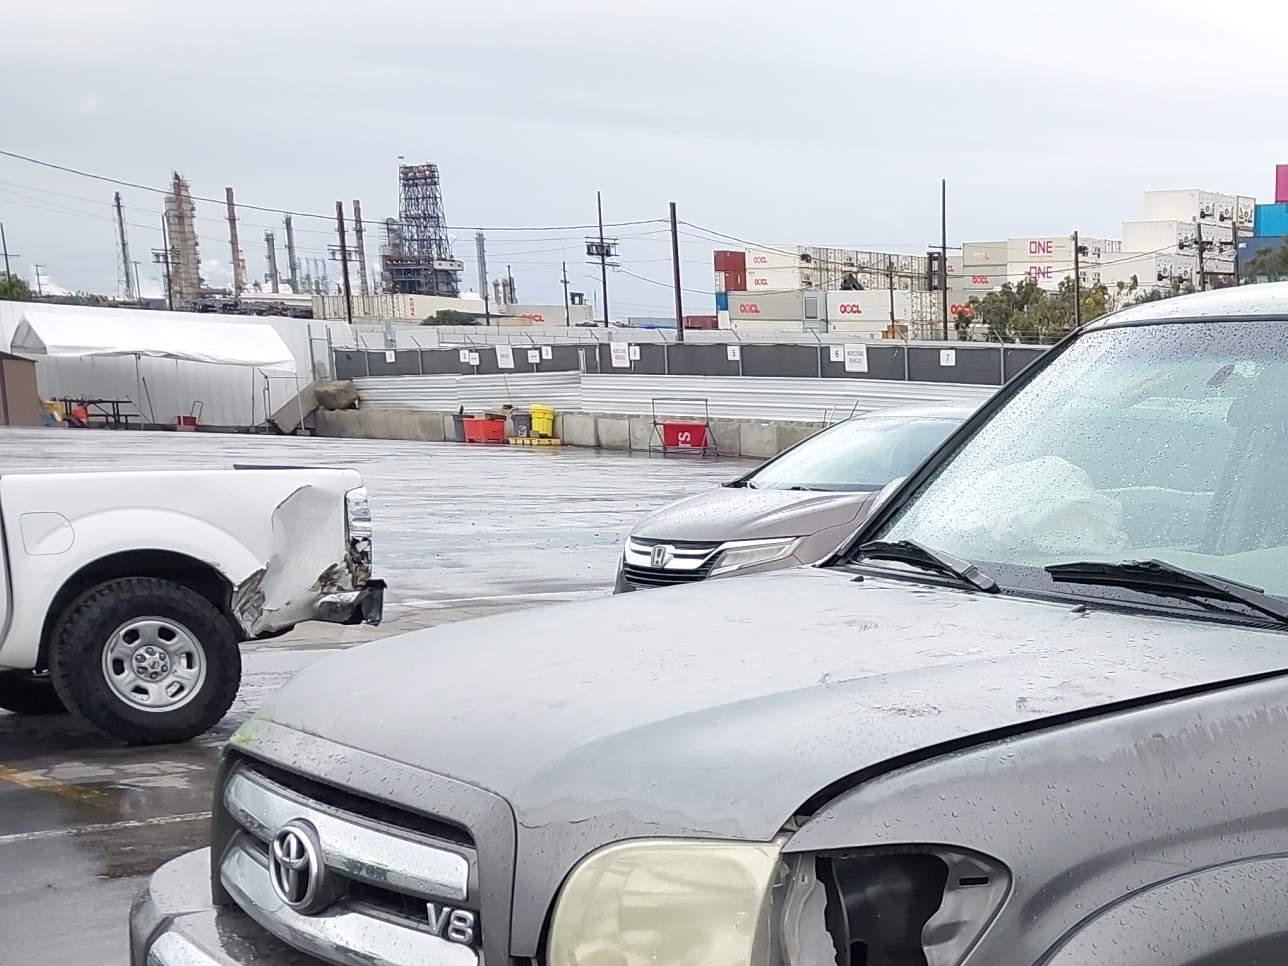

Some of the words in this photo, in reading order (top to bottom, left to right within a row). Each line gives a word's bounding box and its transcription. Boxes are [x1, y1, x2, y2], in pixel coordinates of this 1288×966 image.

[1029, 240, 1053, 254] ONE
[739, 303, 761, 314] OOCL
[839, 303, 862, 314] OOCL
[426, 901, 475, 943] V8
